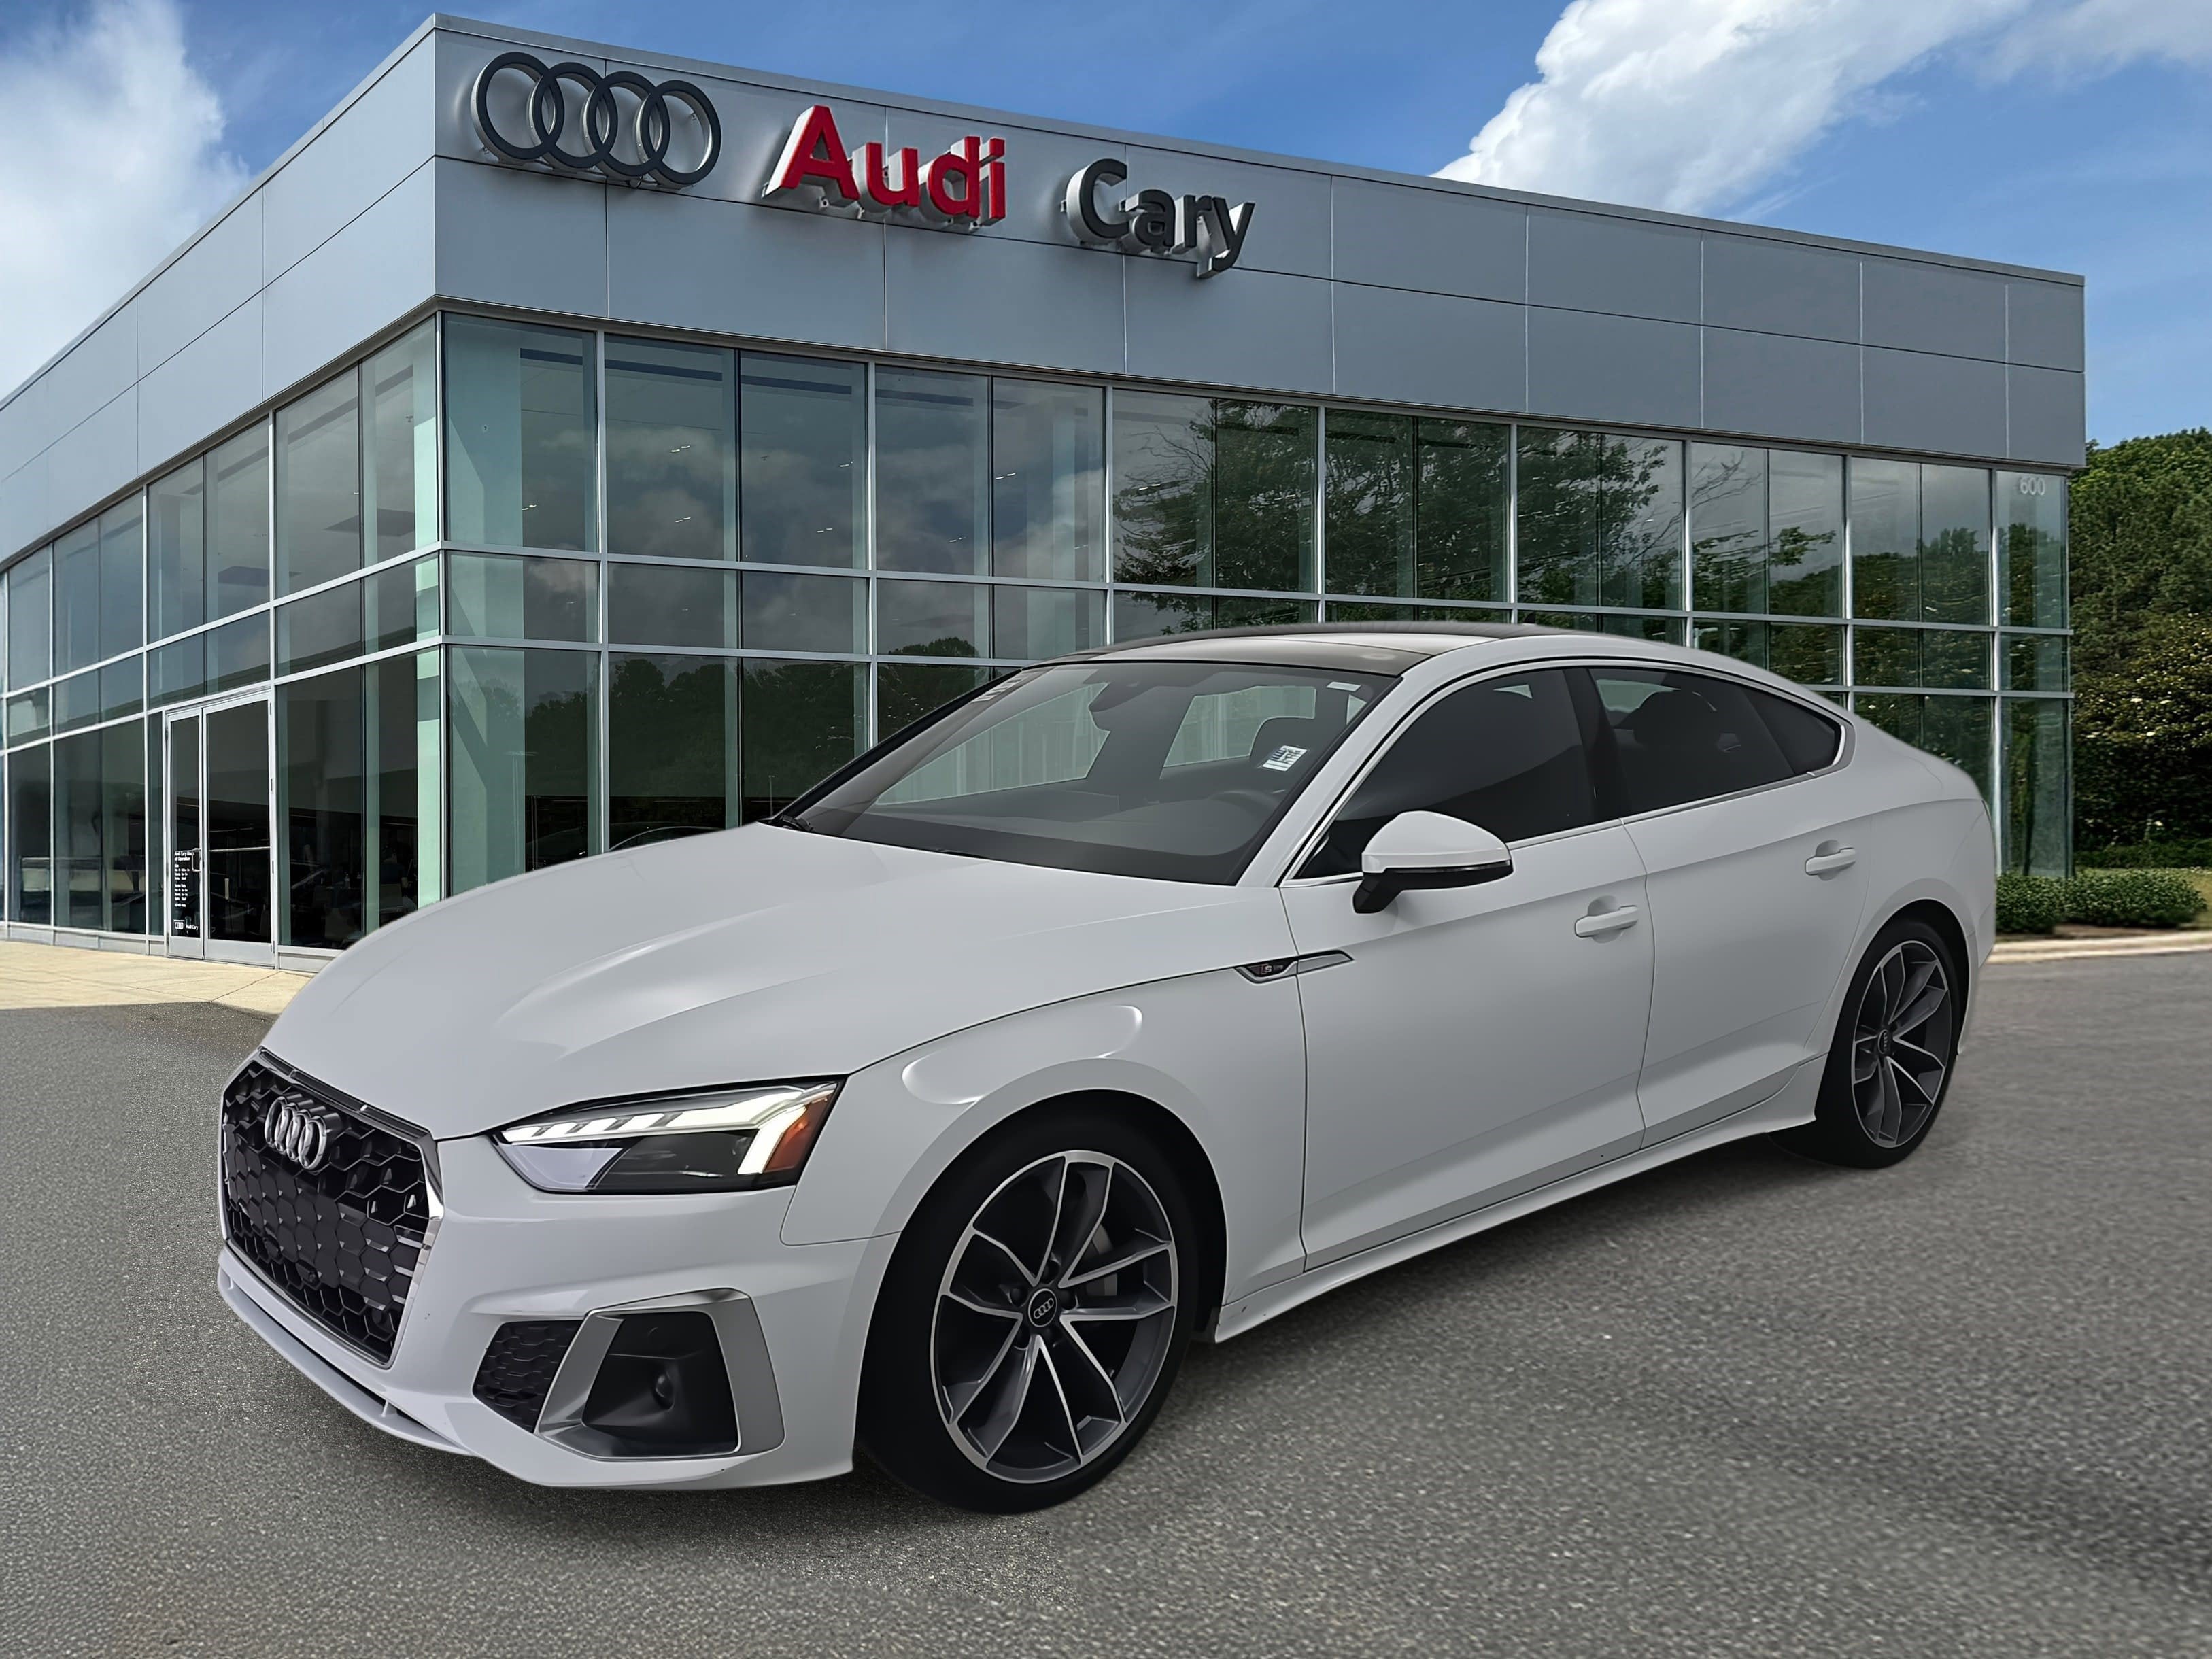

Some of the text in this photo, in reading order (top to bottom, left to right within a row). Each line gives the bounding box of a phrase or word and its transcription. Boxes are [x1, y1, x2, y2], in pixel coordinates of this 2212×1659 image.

[764, 104, 1256, 277] Audi Cary
[2020, 477, 2045, 496] 600
